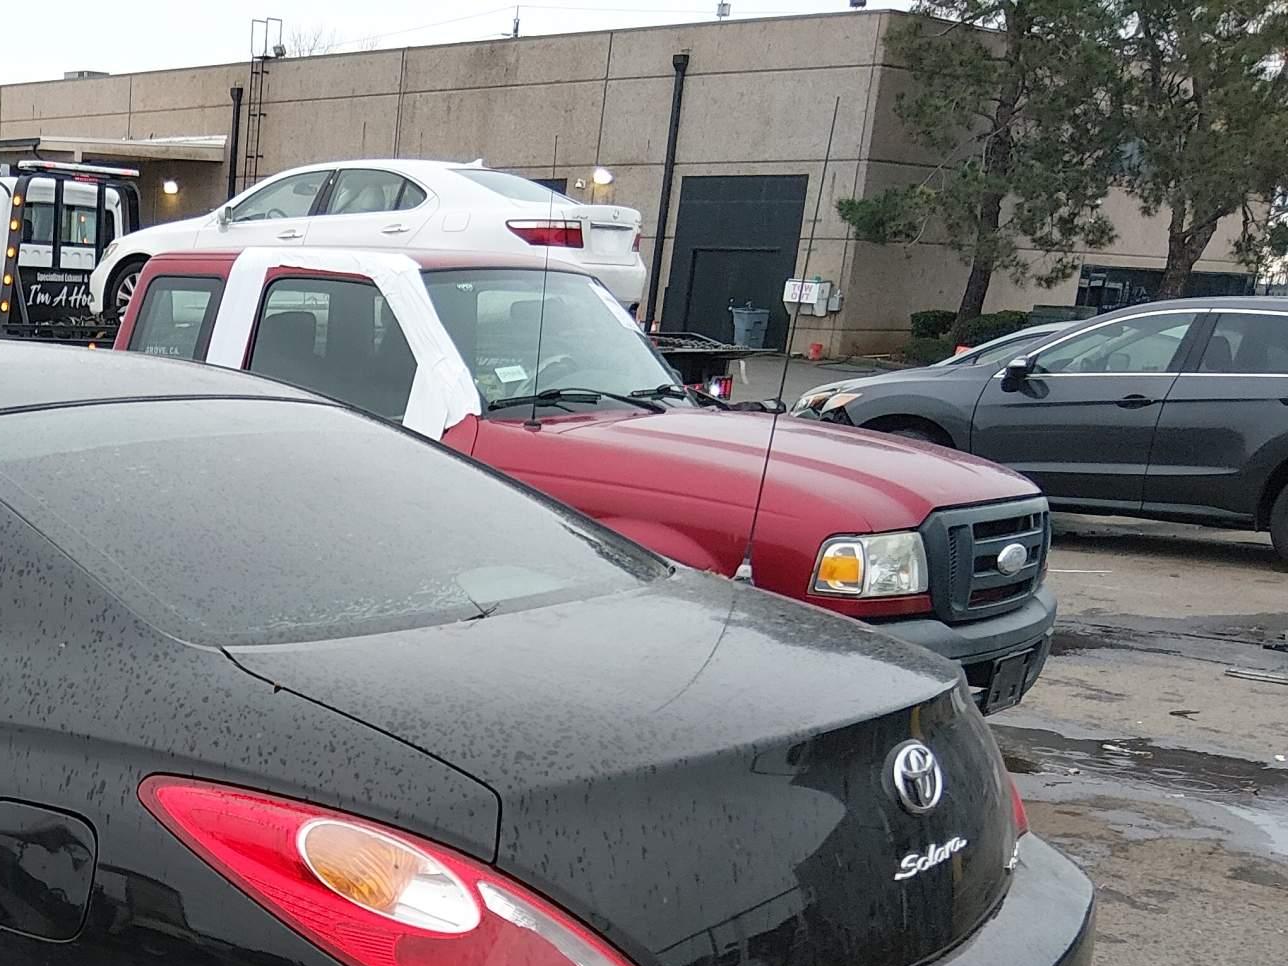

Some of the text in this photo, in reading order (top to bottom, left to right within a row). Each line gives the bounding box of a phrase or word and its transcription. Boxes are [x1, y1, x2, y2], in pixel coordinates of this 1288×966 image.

[26, 283, 52, 306] I'm
[52, 285, 68, 307] A
[791, 283, 813, 292] TOW
[894, 836, 968, 881] Solara
